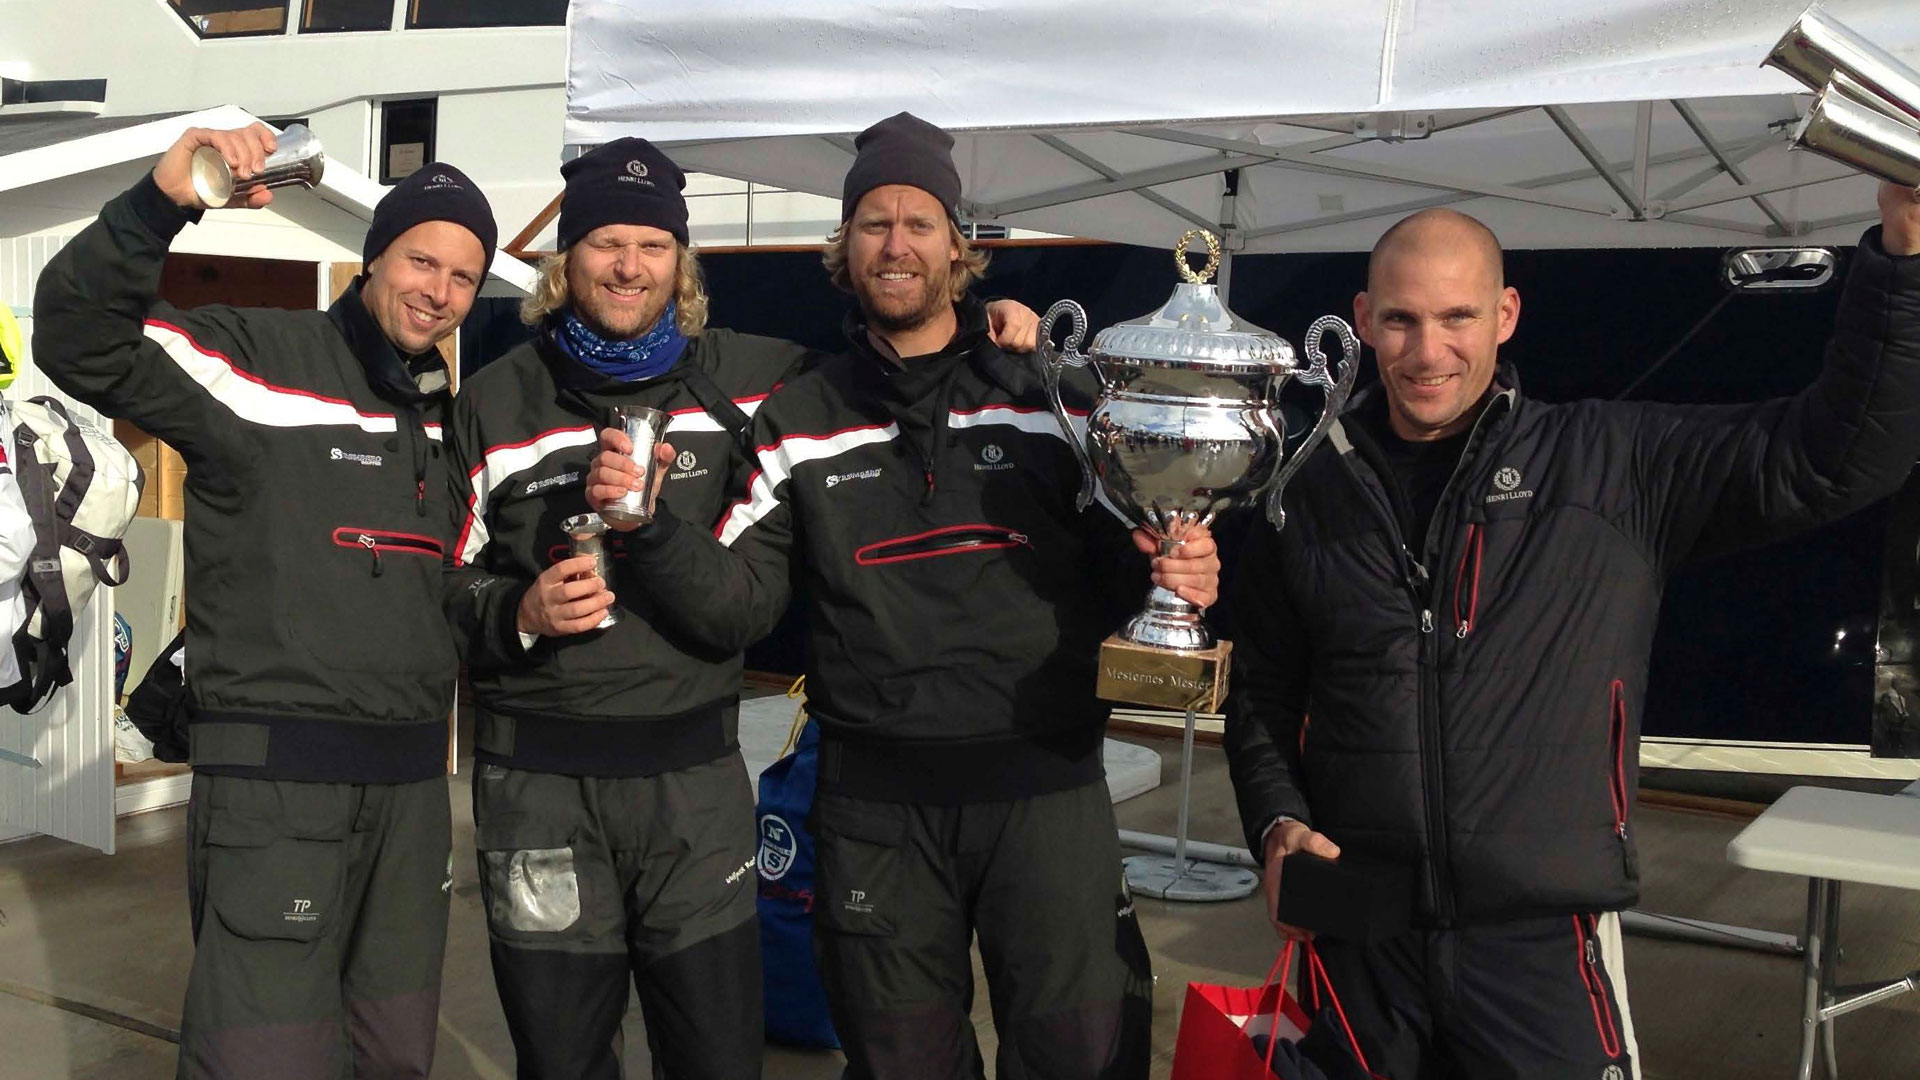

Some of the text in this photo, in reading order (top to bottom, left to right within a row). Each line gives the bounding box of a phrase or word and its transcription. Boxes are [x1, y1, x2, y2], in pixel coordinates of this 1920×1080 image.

[688, 468, 708, 478] LLOYD
[1486, 490, 1533, 503] HENRI LLOYD
[1105, 666, 1211, 690] Mesternes Mester
[767, 852, 781, 869] S
[850, 889, 866, 903] TP
[293, 899, 312, 913] TP
